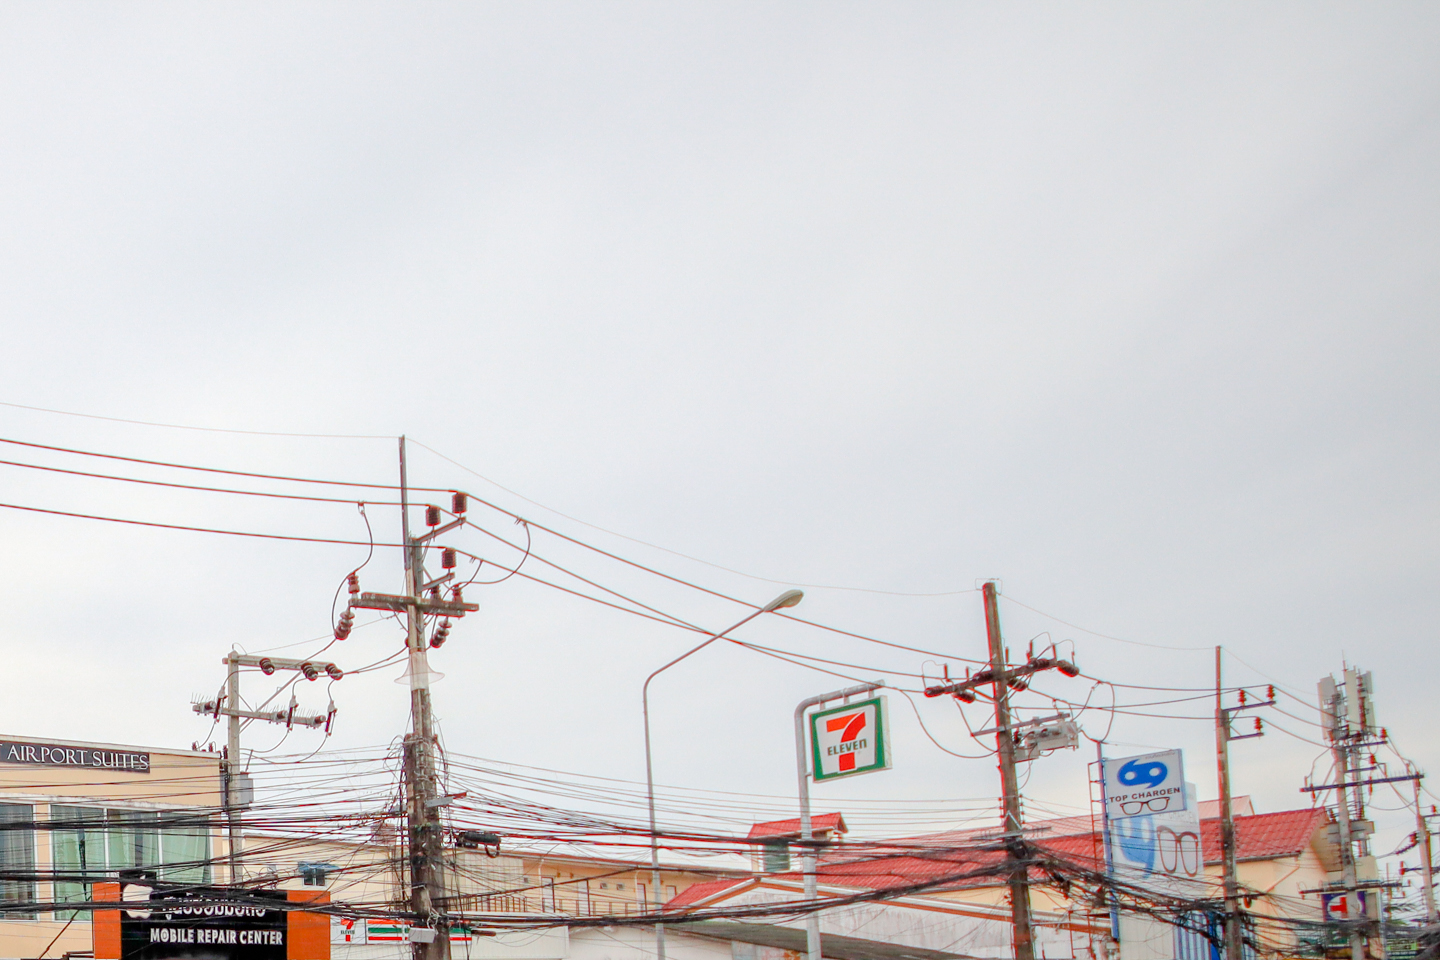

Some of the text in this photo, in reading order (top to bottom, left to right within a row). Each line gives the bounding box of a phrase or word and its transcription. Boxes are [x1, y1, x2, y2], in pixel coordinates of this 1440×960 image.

[7, 744, 88, 766] AIRPORT
[91, 751, 149, 770] SUITES
[1109, 787, 1181, 803] TOP CHAROEN
[150, 928, 283, 946] MOBILE REPAIR CENTER
